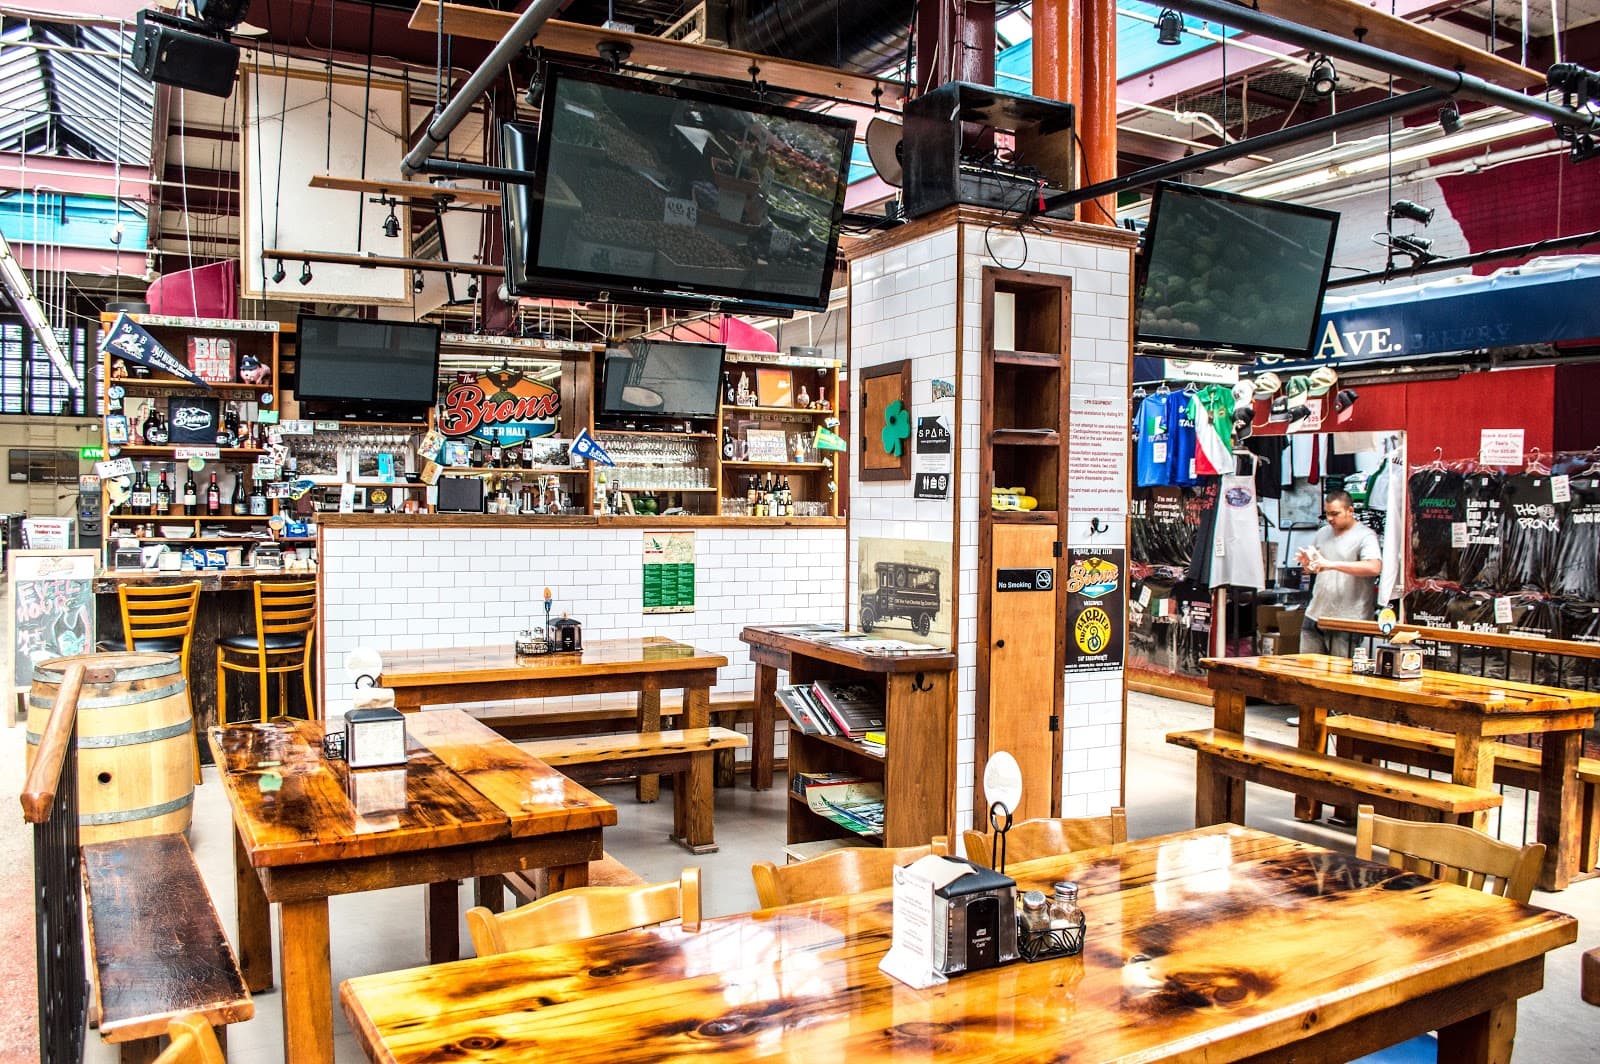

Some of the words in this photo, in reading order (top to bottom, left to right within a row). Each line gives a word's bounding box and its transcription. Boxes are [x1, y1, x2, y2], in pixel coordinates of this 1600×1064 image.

[194, 337, 231, 359] BIG
[1314, 320, 1402, 360] AVE.
[194, 360, 231, 378] PUN
[459, 374, 475, 384] The
[440, 385, 559, 435] Bronx
[918, 428, 949, 438] SPARE
[998, 581, 1007, 589] No
[1007, 581, 1032, 589] Smoking
